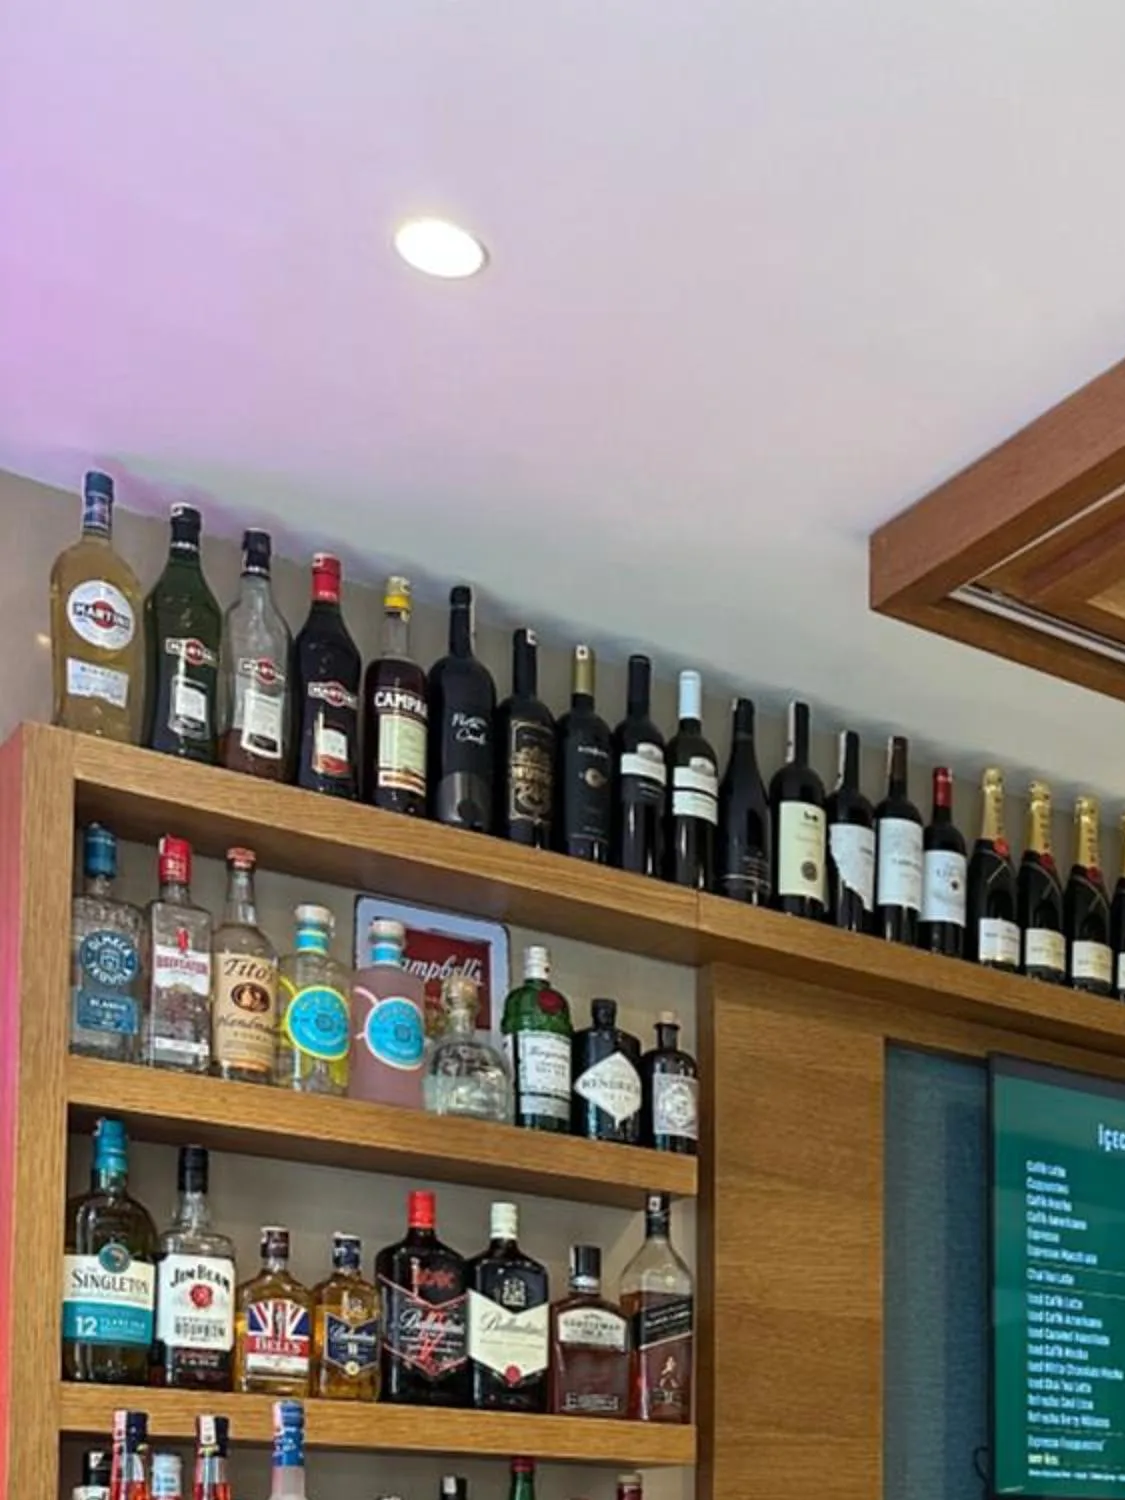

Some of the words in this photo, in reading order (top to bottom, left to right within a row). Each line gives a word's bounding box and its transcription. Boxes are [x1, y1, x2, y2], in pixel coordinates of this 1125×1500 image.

[401, 954, 484, 987] ampbell's
[72, 1269, 150, 1294] SINGLETON
[170, 1267, 195, 1288] JIM
[197, 1263, 230, 1292] BEAM
[75, 1316, 97, 1337] 12
